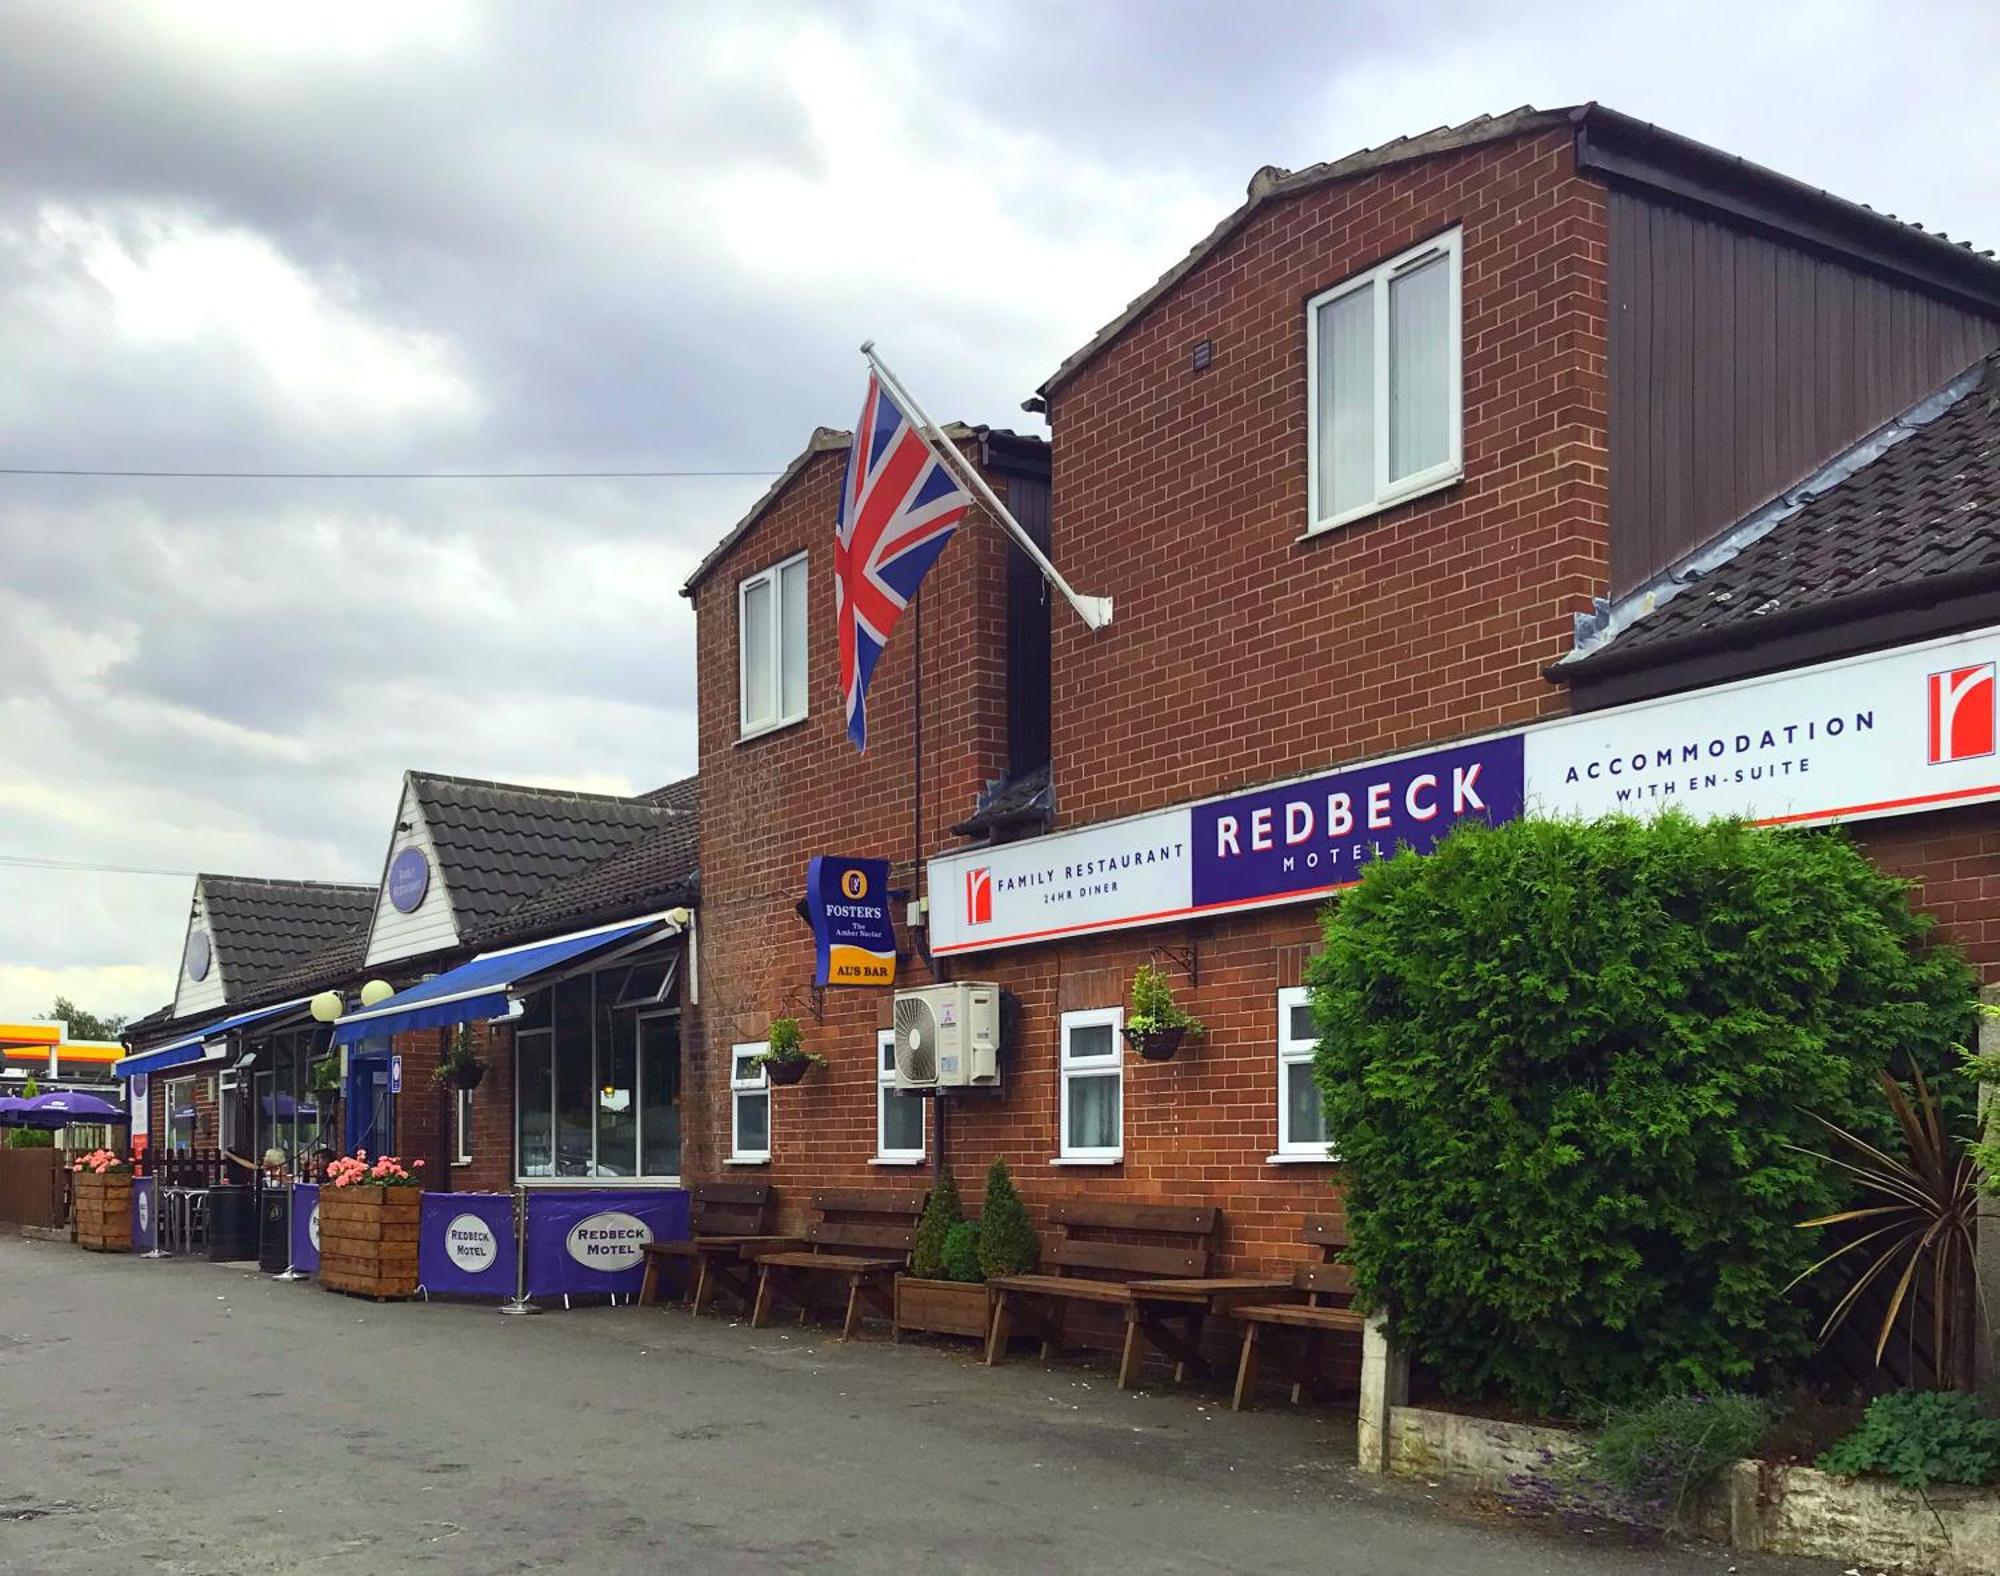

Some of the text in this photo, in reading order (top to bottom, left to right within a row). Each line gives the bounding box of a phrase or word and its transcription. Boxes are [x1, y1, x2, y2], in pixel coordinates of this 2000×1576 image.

[1565, 710, 1875, 784] ACCOMMODATION
[1616, 757, 1811, 801] WITH EN-SUITE
[1217, 762, 1487, 858] REDBECK
[1283, 841, 1384, 873] MOTEL
[998, 843, 1183, 892] FAMILY RESTAURANT
[1044, 881, 1119, 904] 24HR DINER
[826, 904, 882, 919] FOSTER'S
[835, 929, 883, 939] Amber Nectar
[852, 922, 866, 931] The
[863, 966, 888, 978] BAR
[451, 1228, 491, 1243] REDBECK
[577, 1227, 646, 1241] REDBECK
[456, 1244, 488, 1258] MOTEL
[586, 1242, 636, 1256] MOTEL
